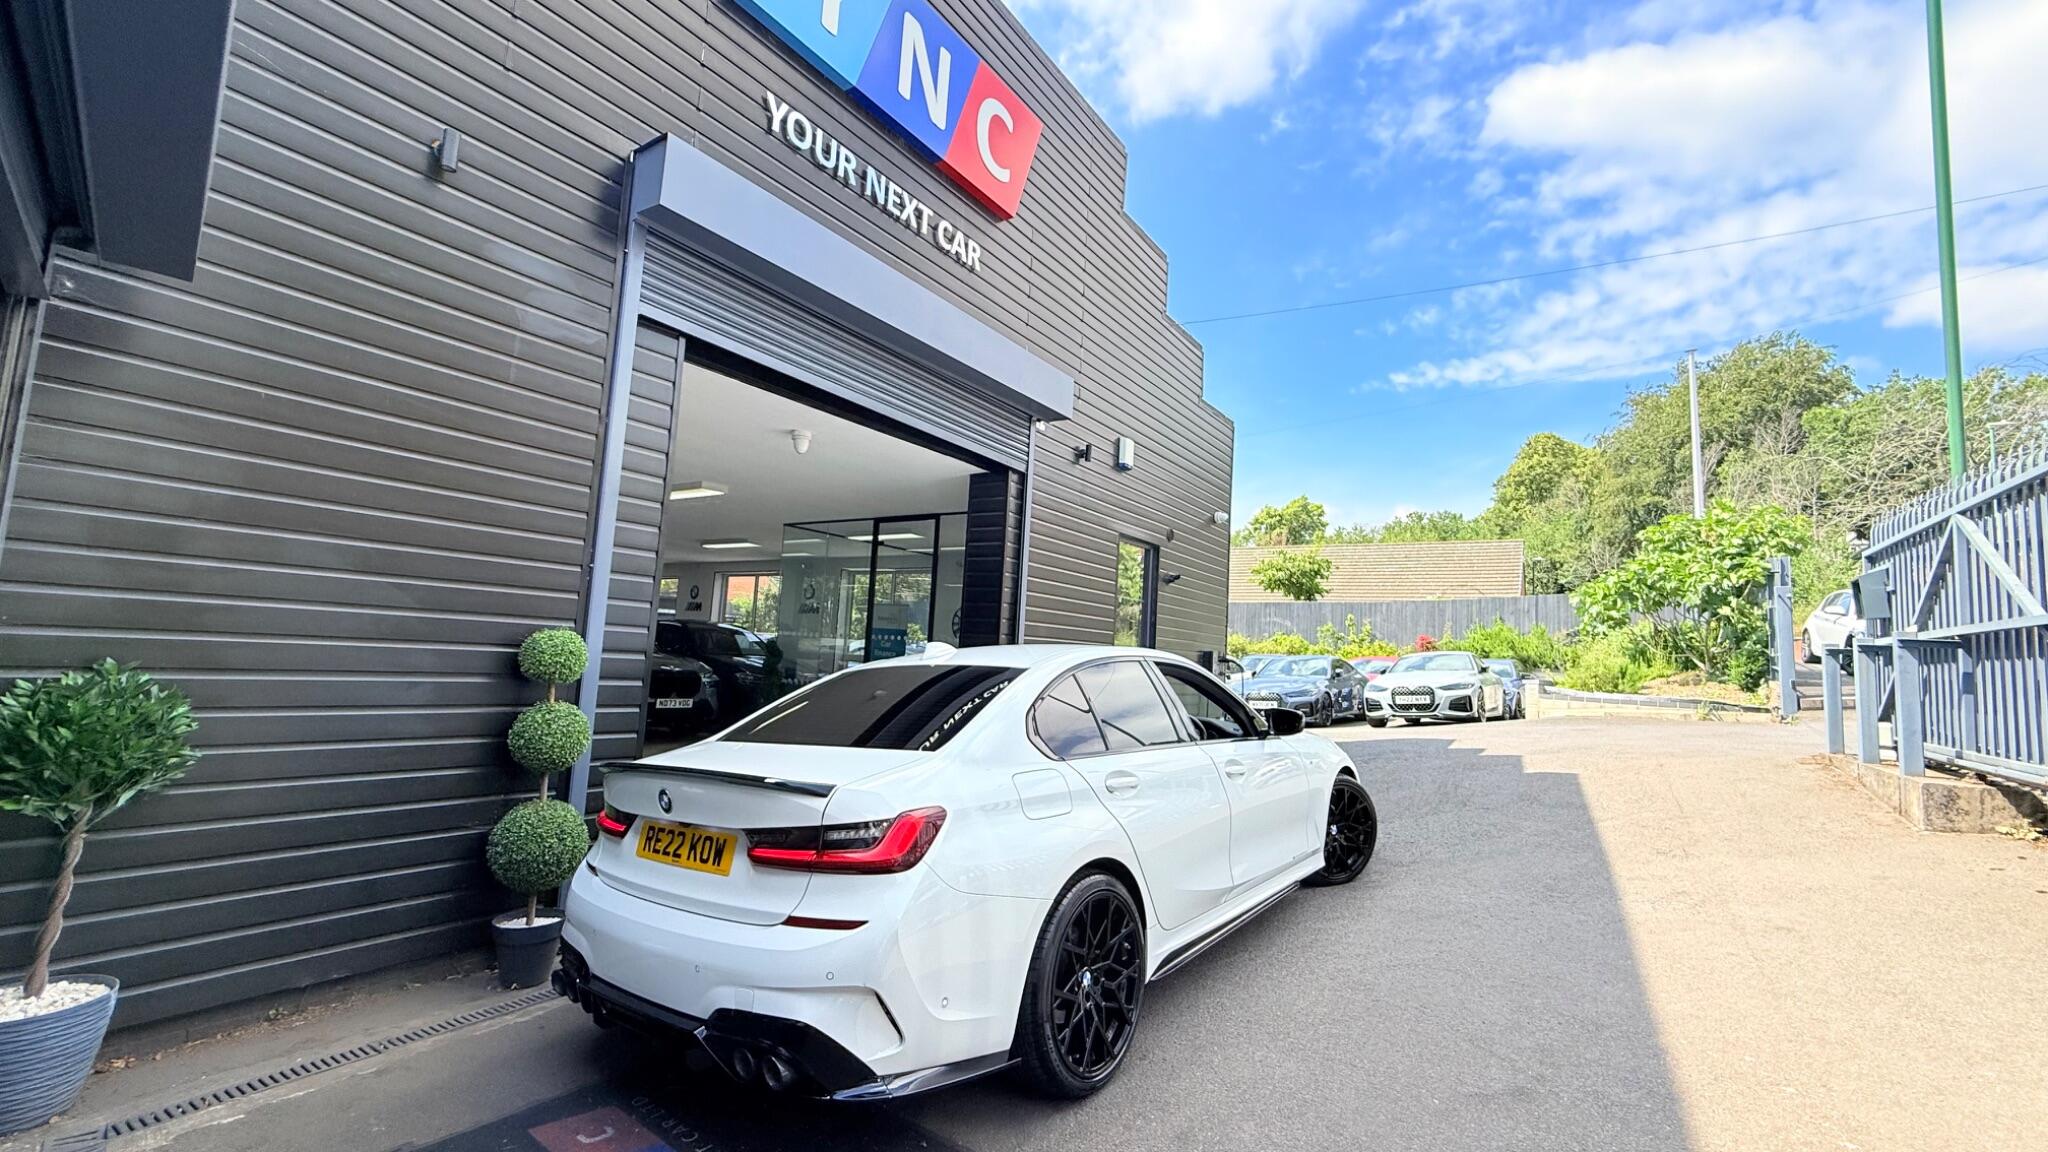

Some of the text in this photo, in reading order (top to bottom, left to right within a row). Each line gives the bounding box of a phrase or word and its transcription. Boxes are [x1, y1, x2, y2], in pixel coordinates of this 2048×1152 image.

[766, 91, 981, 271] YOUR NEXT CAR
[643, 825, 727, 867] RE22 KOW
